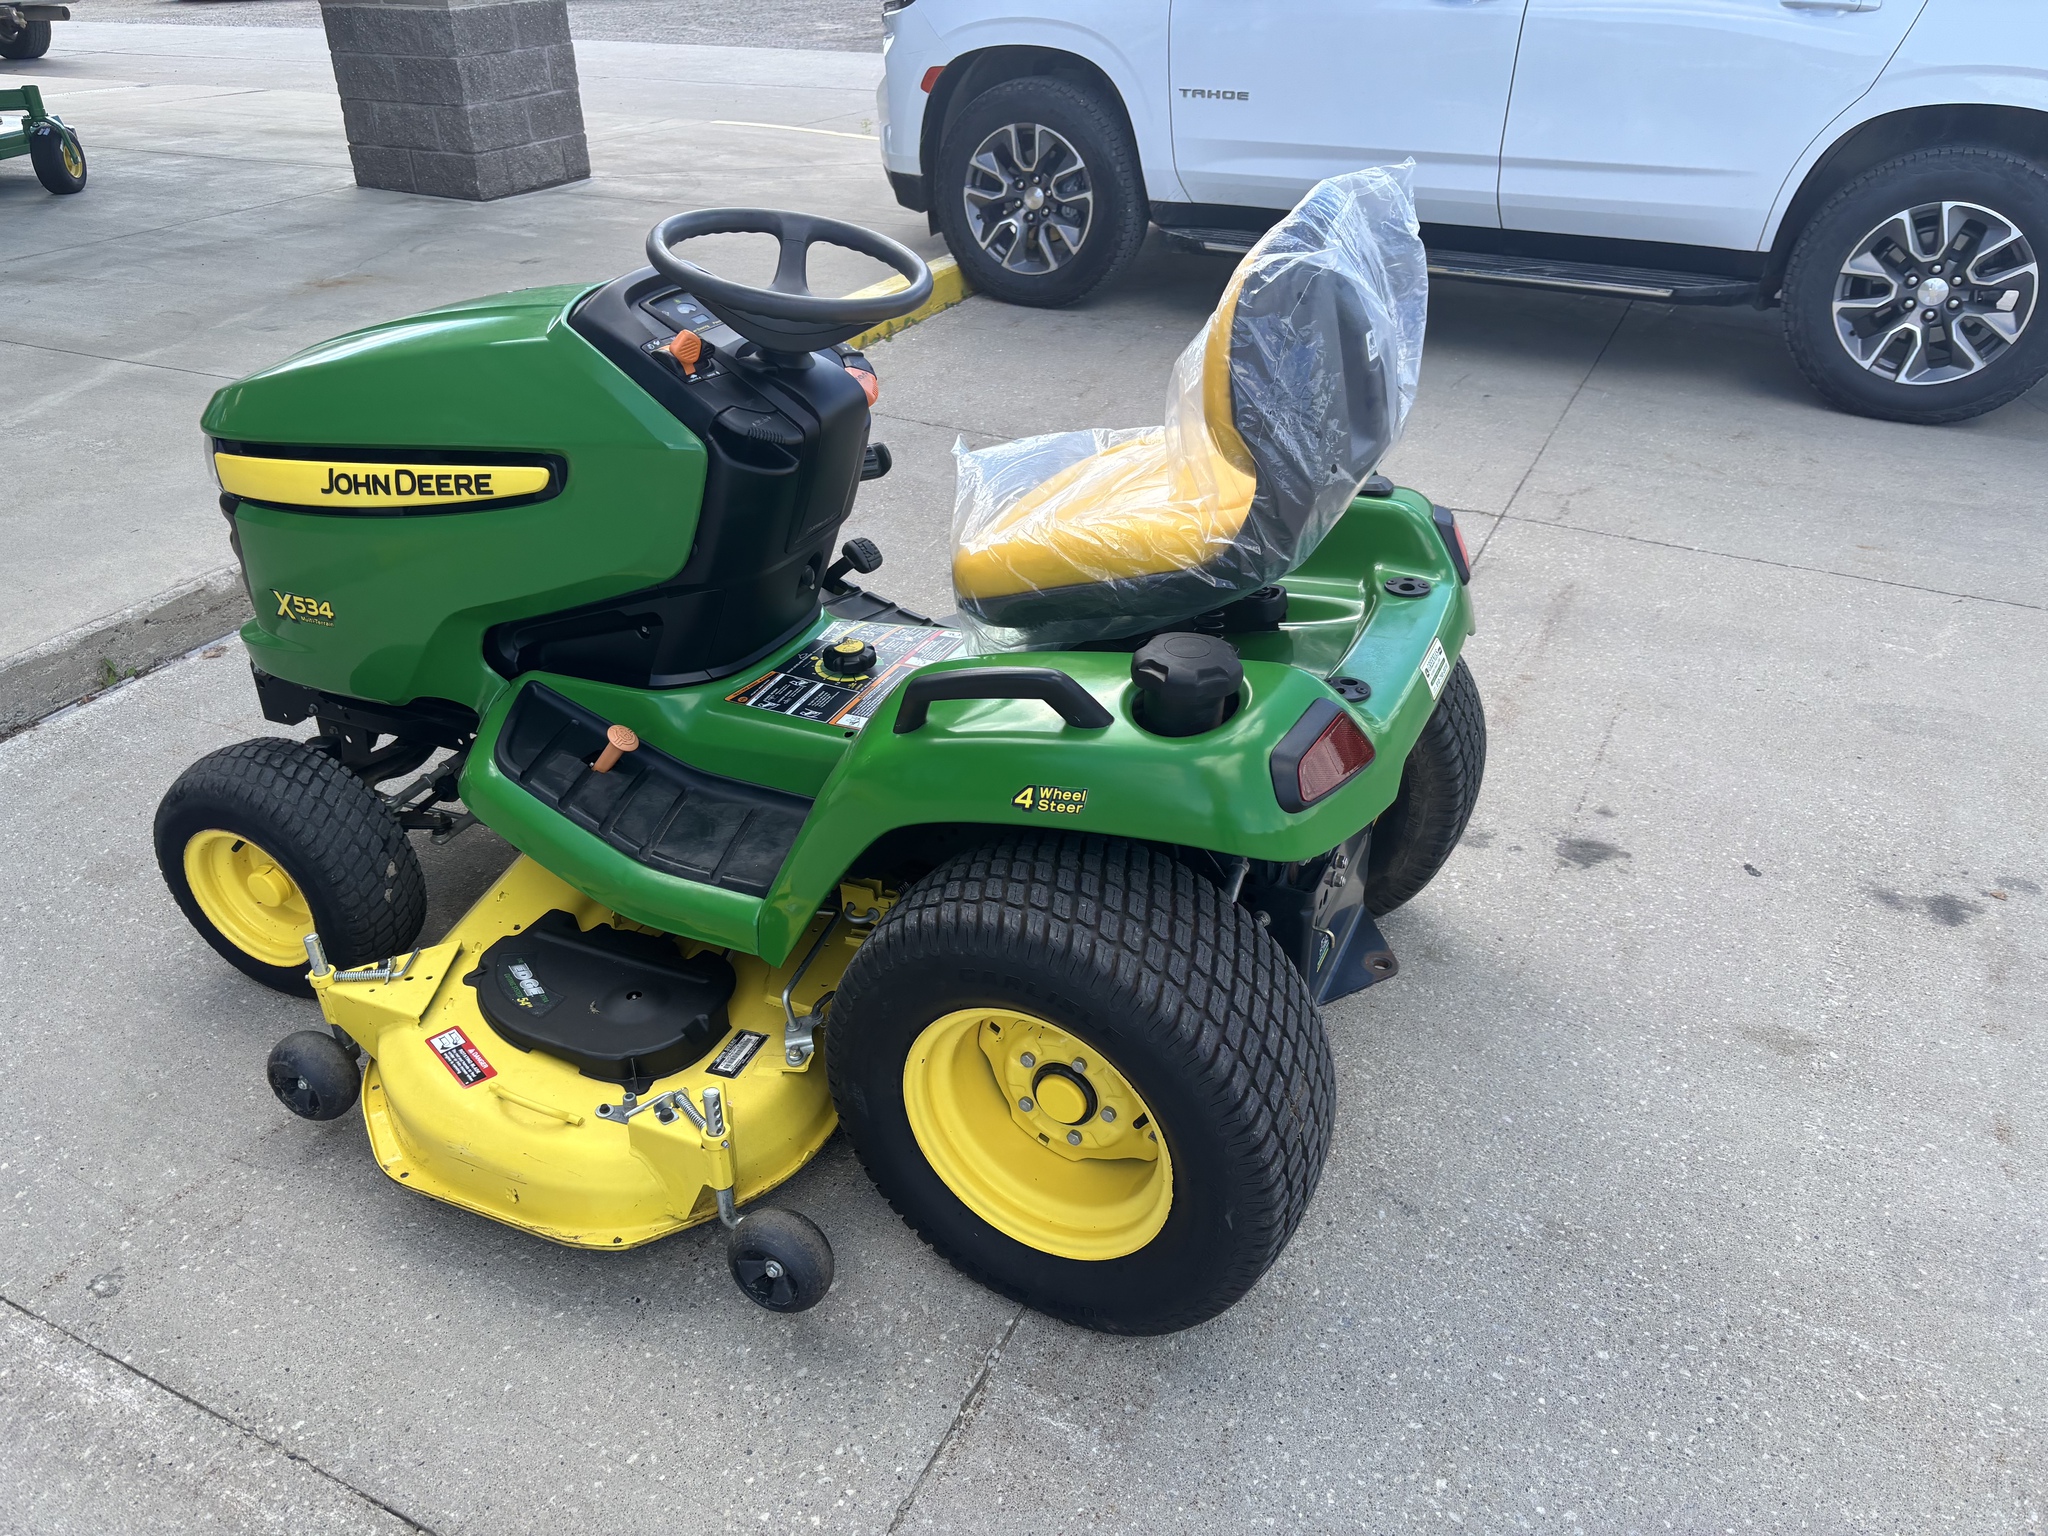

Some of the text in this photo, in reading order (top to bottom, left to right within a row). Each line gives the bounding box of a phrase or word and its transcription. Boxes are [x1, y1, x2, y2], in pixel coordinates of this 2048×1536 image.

[1178, 88, 1250, 101] TAHOE
[321, 468, 495, 496] JOHN DEERE
[271, 590, 336, 620] X534
[1013, 786, 1035, 809] 4
[1039, 786, 1087, 802] Wheel
[1037, 799, 1084, 814] Steer
[508, 962, 546, 998] EDGE
[471, 1051, 489, 1069] DANGER
